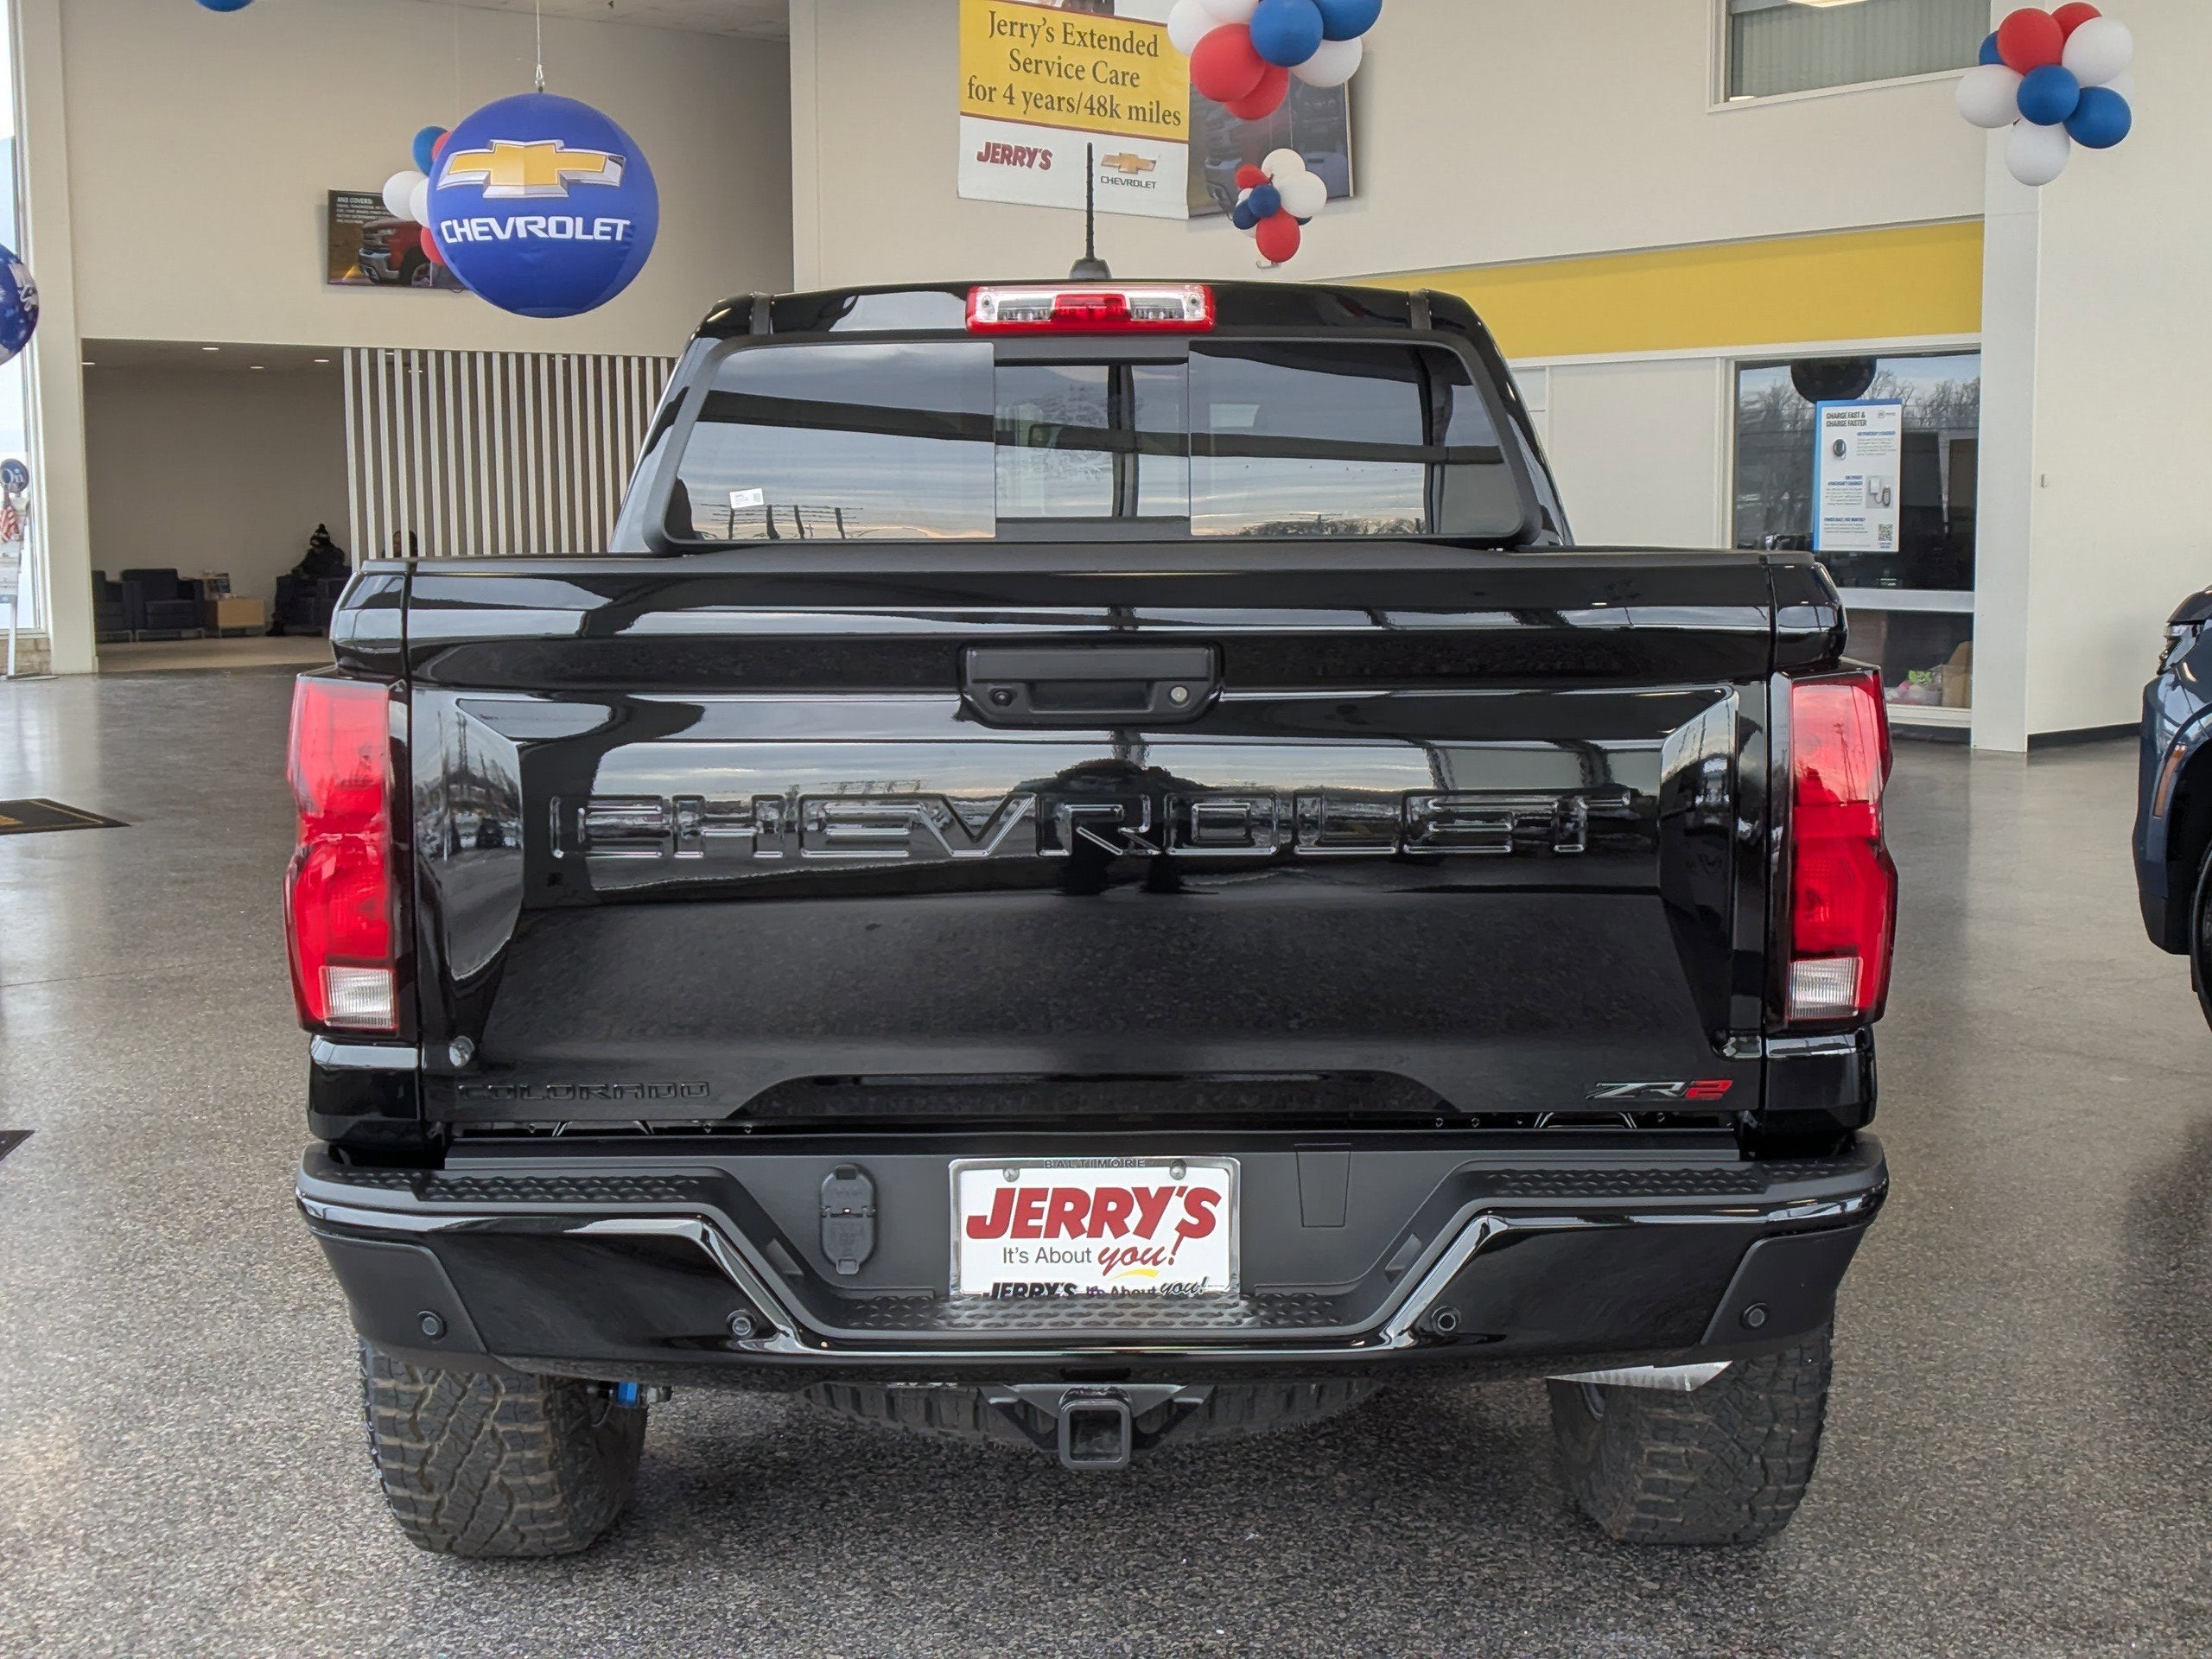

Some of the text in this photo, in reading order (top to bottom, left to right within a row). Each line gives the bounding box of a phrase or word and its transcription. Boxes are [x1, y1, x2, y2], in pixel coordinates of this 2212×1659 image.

[988, 10, 1159, 57] Jerry's Extended
[1008, 48, 1141, 88] Service Care
[967, 76, 1182, 127] for 4 years/48k miles
[977, 142, 1053, 170] JERRY'S
[1100, 175, 1157, 189] CHEVROLET
[441, 216, 630, 244] CHEVROLET
[551, 792, 1631, 858] CHEVROLET
[457, 1082, 709, 1100] COLORADO
[1586, 1080, 1733, 1100] ZR2
[1044, 1159, 1147, 1168] BALTIMORE
[966, 1185, 1223, 1240] JERRY'S
[1003, 1236, 1185, 1276] It's About you!
[1160, 1276, 1209, 1295] you!
